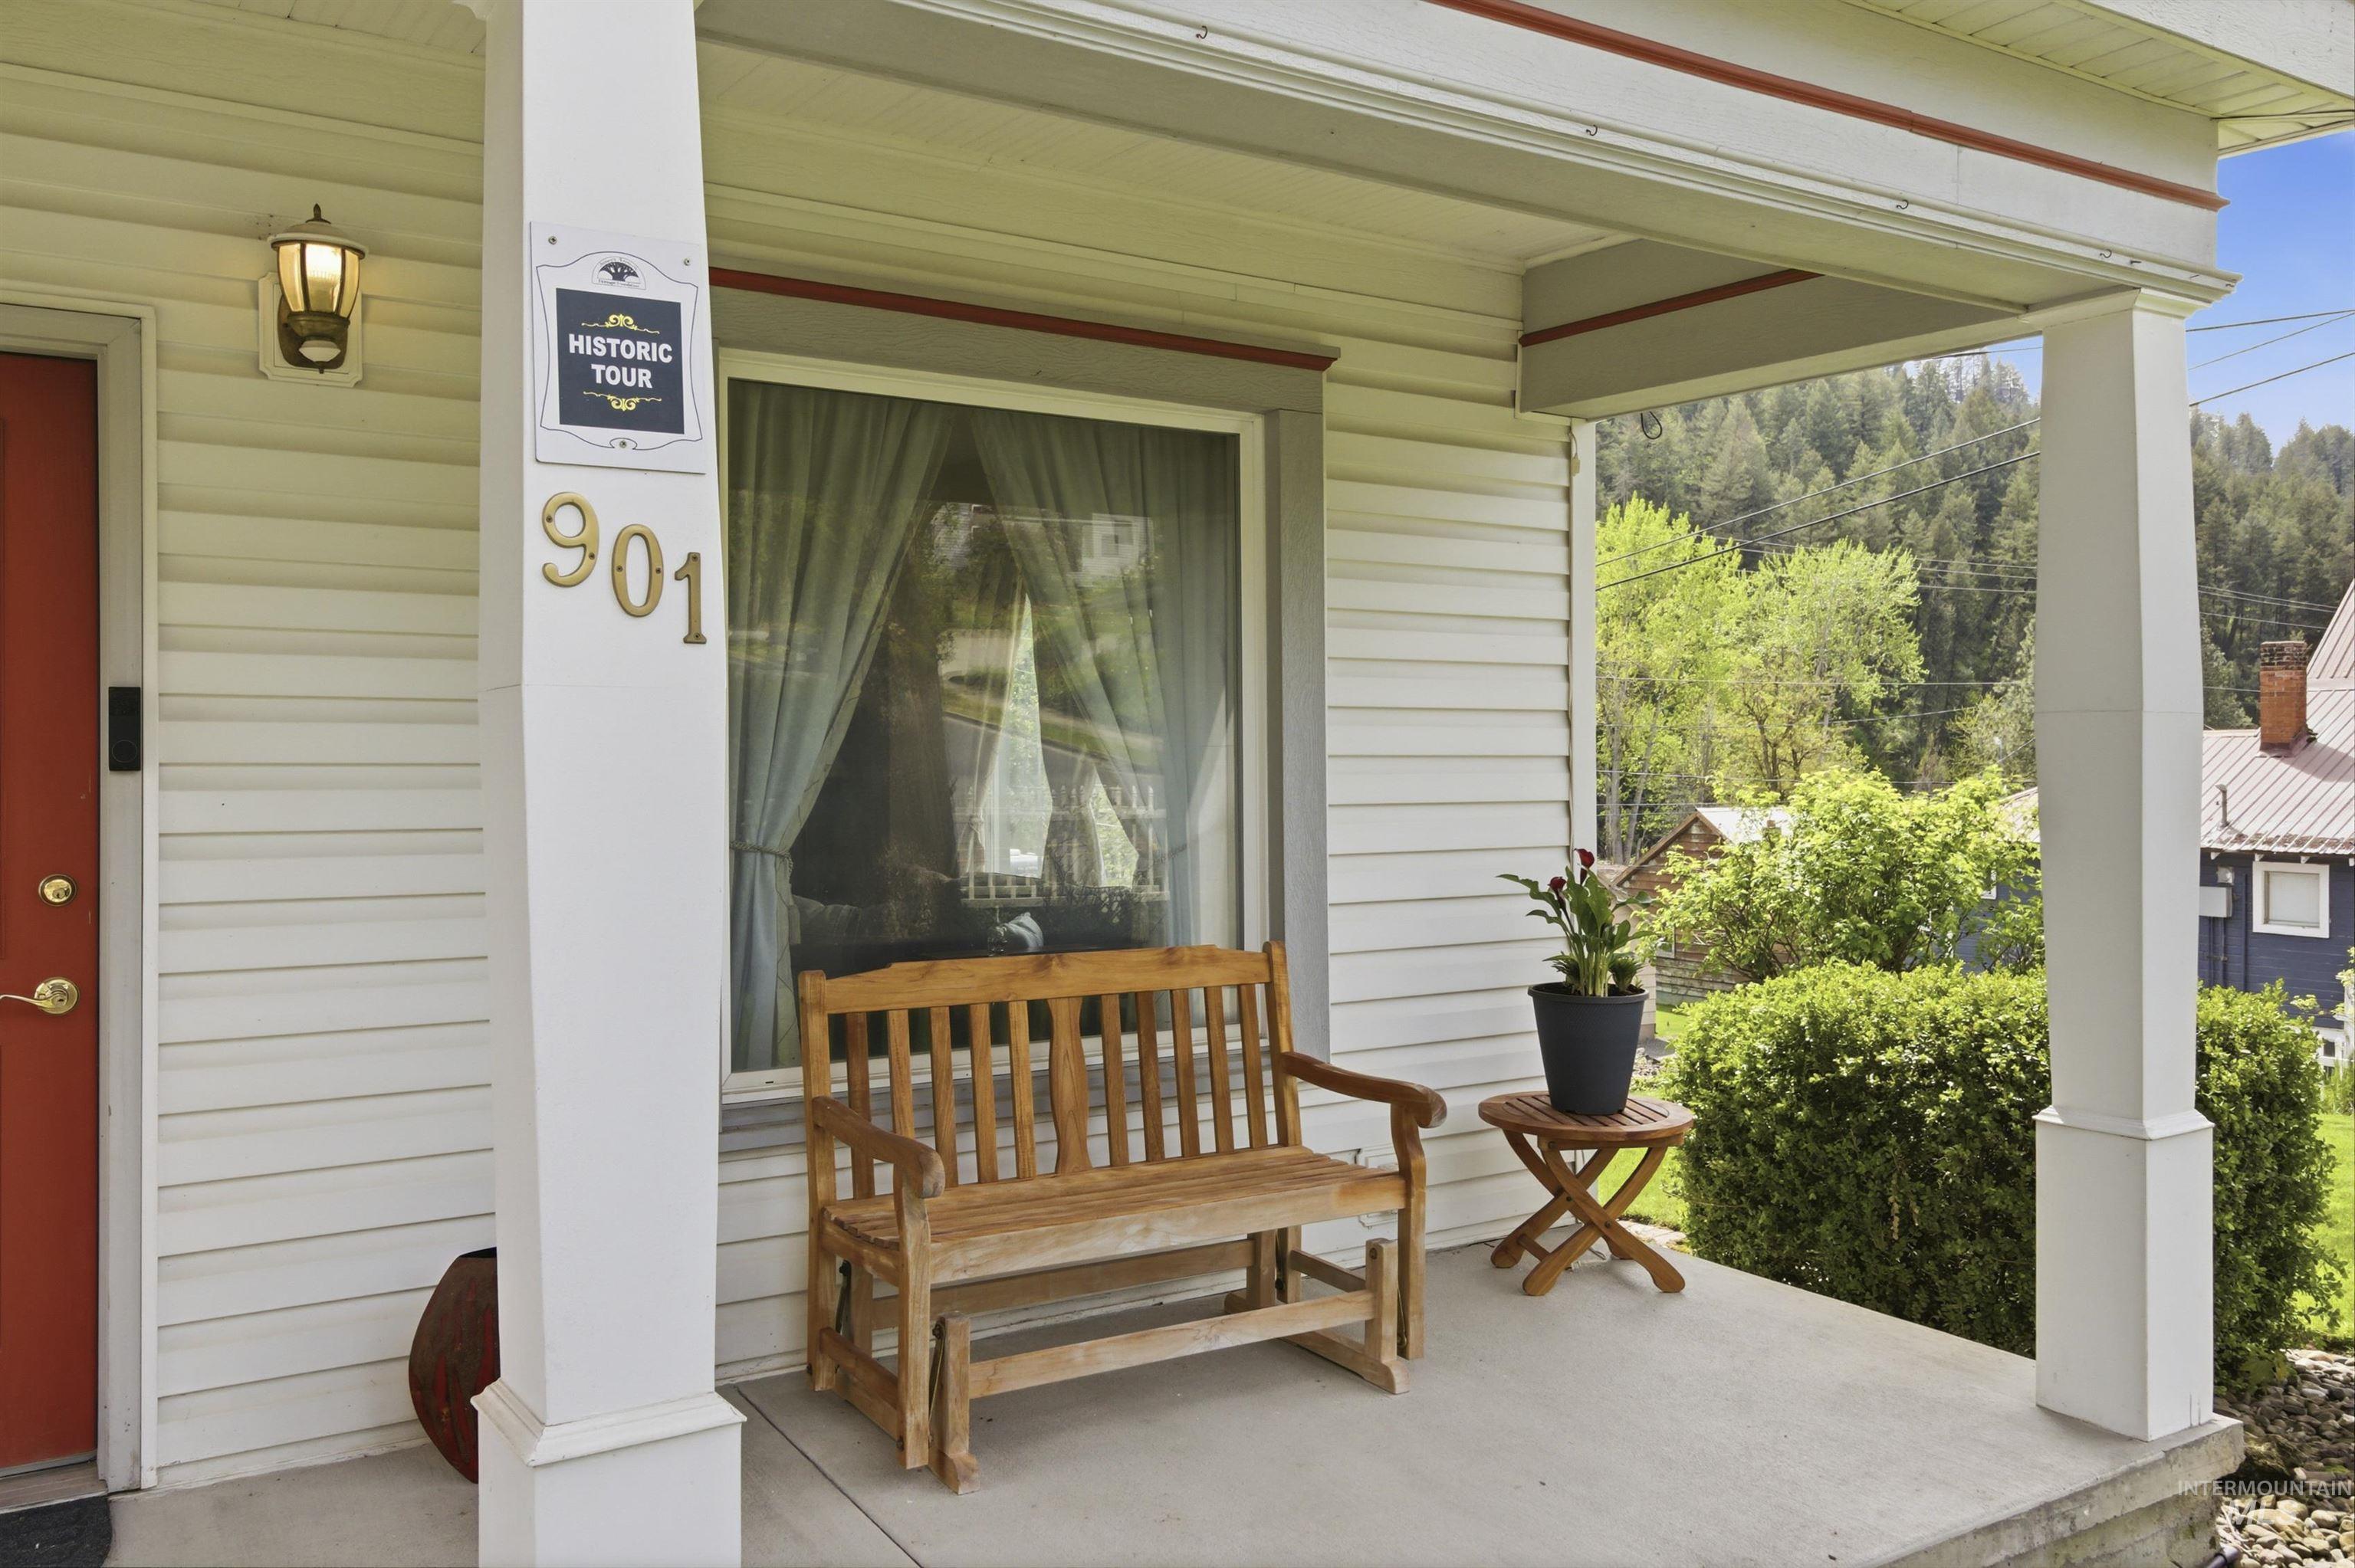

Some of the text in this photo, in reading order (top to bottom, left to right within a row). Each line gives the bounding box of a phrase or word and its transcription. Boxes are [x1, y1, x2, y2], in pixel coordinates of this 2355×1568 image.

[569, 333, 672, 363] HISTORIC
[591, 363, 652, 389] TOUR
[542, 491, 707, 645] 901
